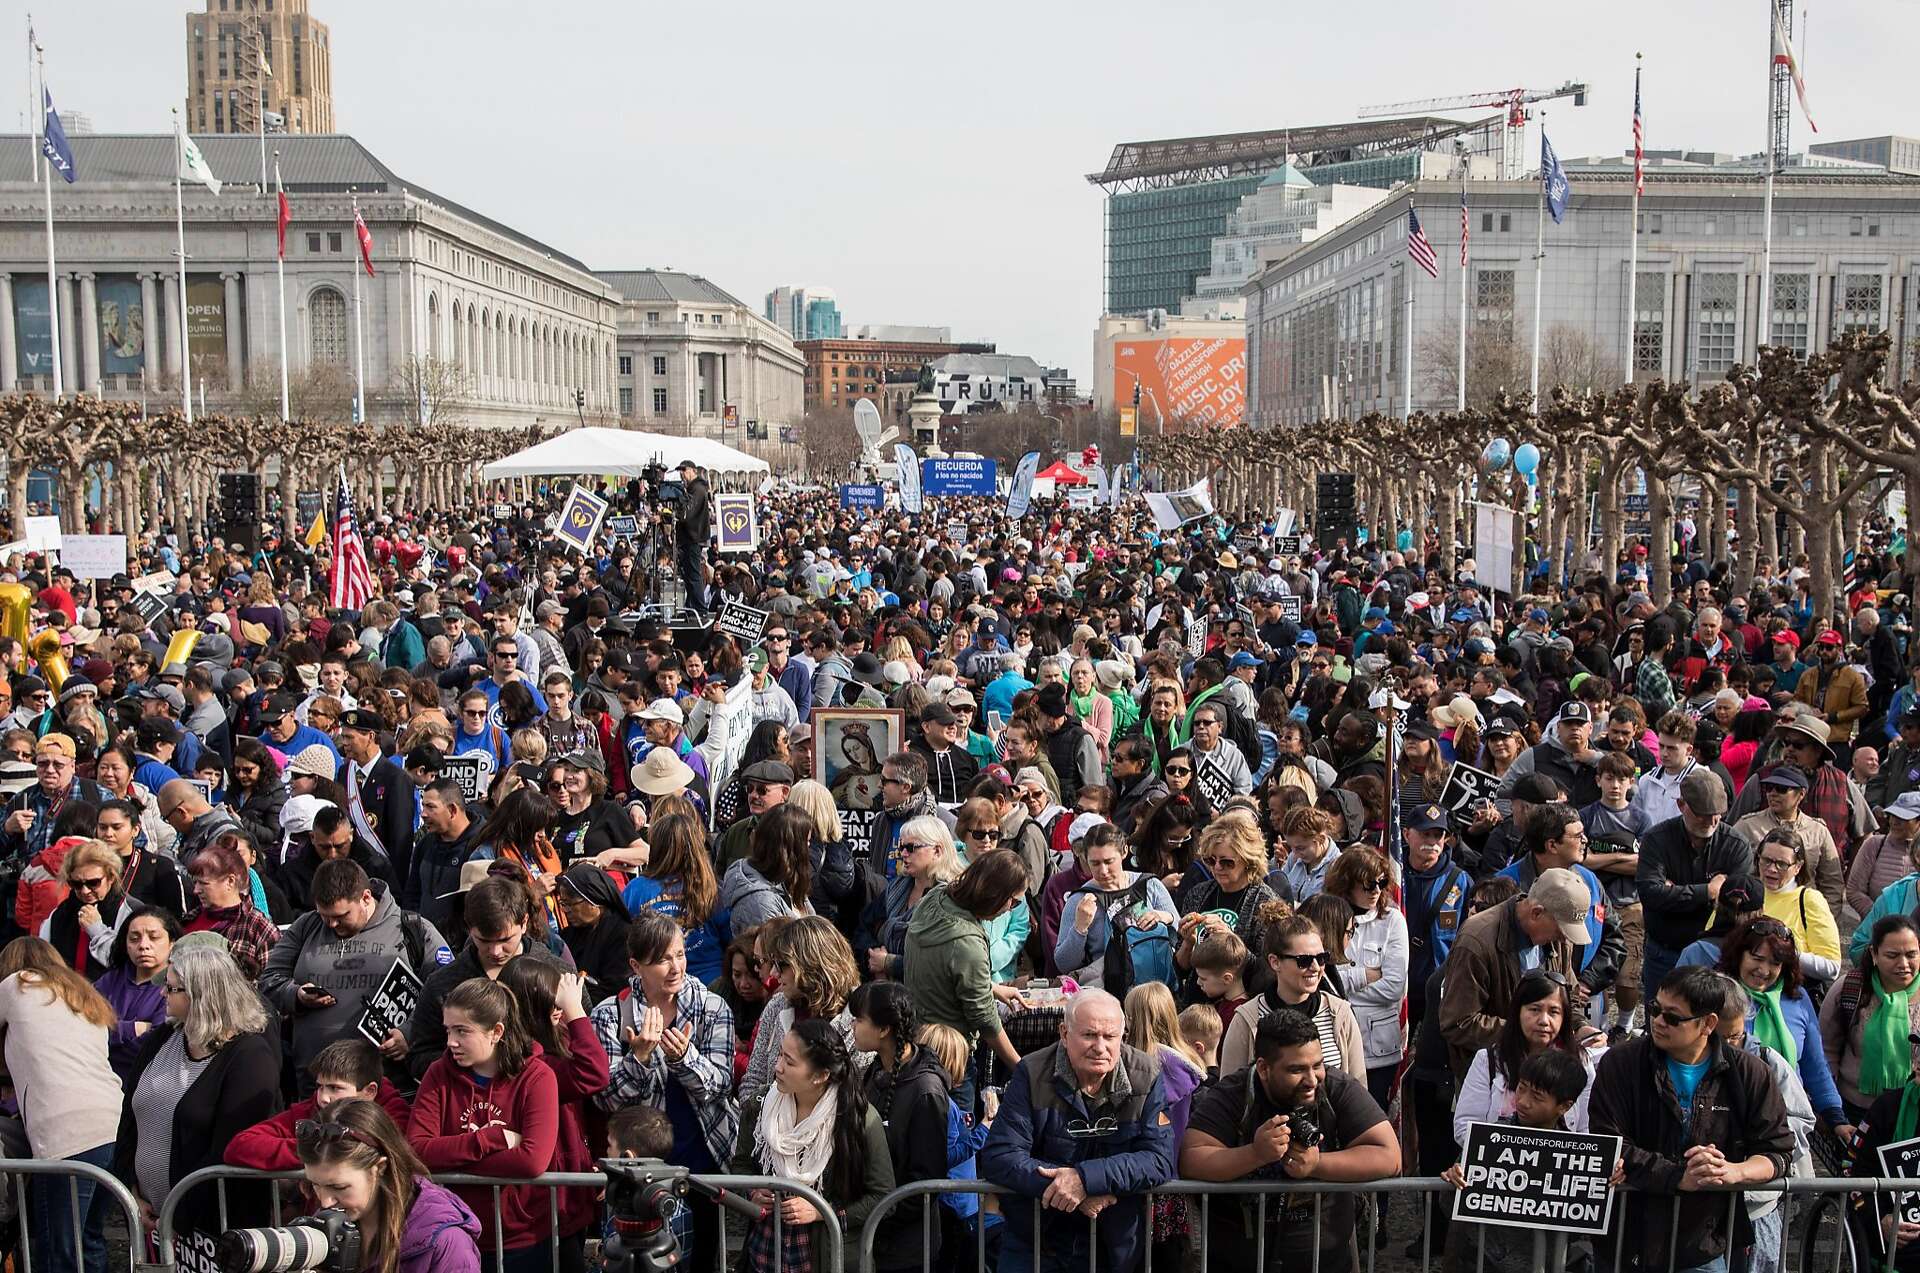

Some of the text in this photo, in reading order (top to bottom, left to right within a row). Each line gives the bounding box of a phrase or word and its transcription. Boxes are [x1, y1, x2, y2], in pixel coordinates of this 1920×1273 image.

[188, 305, 221, 315] OPEN
[1174, 337, 1228, 382] TRANSFORMS
[1173, 363, 1213, 396] THROUGH
[1217, 380, 1243, 411] JOY
[935, 461, 983, 471] RECUERDA
[848, 487, 876, 495] REMEMBER
[858, 497, 876, 505] Unborn
[722, 614, 762, 632] PRO-LIFE
[732, 611, 745, 620] AM
[748, 615, 762, 624] THE
[720, 622, 758, 639] GENERATION
[1202, 769, 1206, 777] I
[1206, 775, 1220, 790] AM
[838, 810, 860, 823] ZA
[372, 941, 386, 955] OF
[388, 980, 417, 1010] I AM
[460, 1102, 502, 1122] CALIFORNIA
[1501, 1134, 1599, 1151] STUDENTSFORLIFE.ORG
[1477, 1145, 1603, 1173] I AM THE
[1467, 1165, 1608, 1200] PRO-LIFE
[1465, 1193, 1600, 1222] GENERATION
